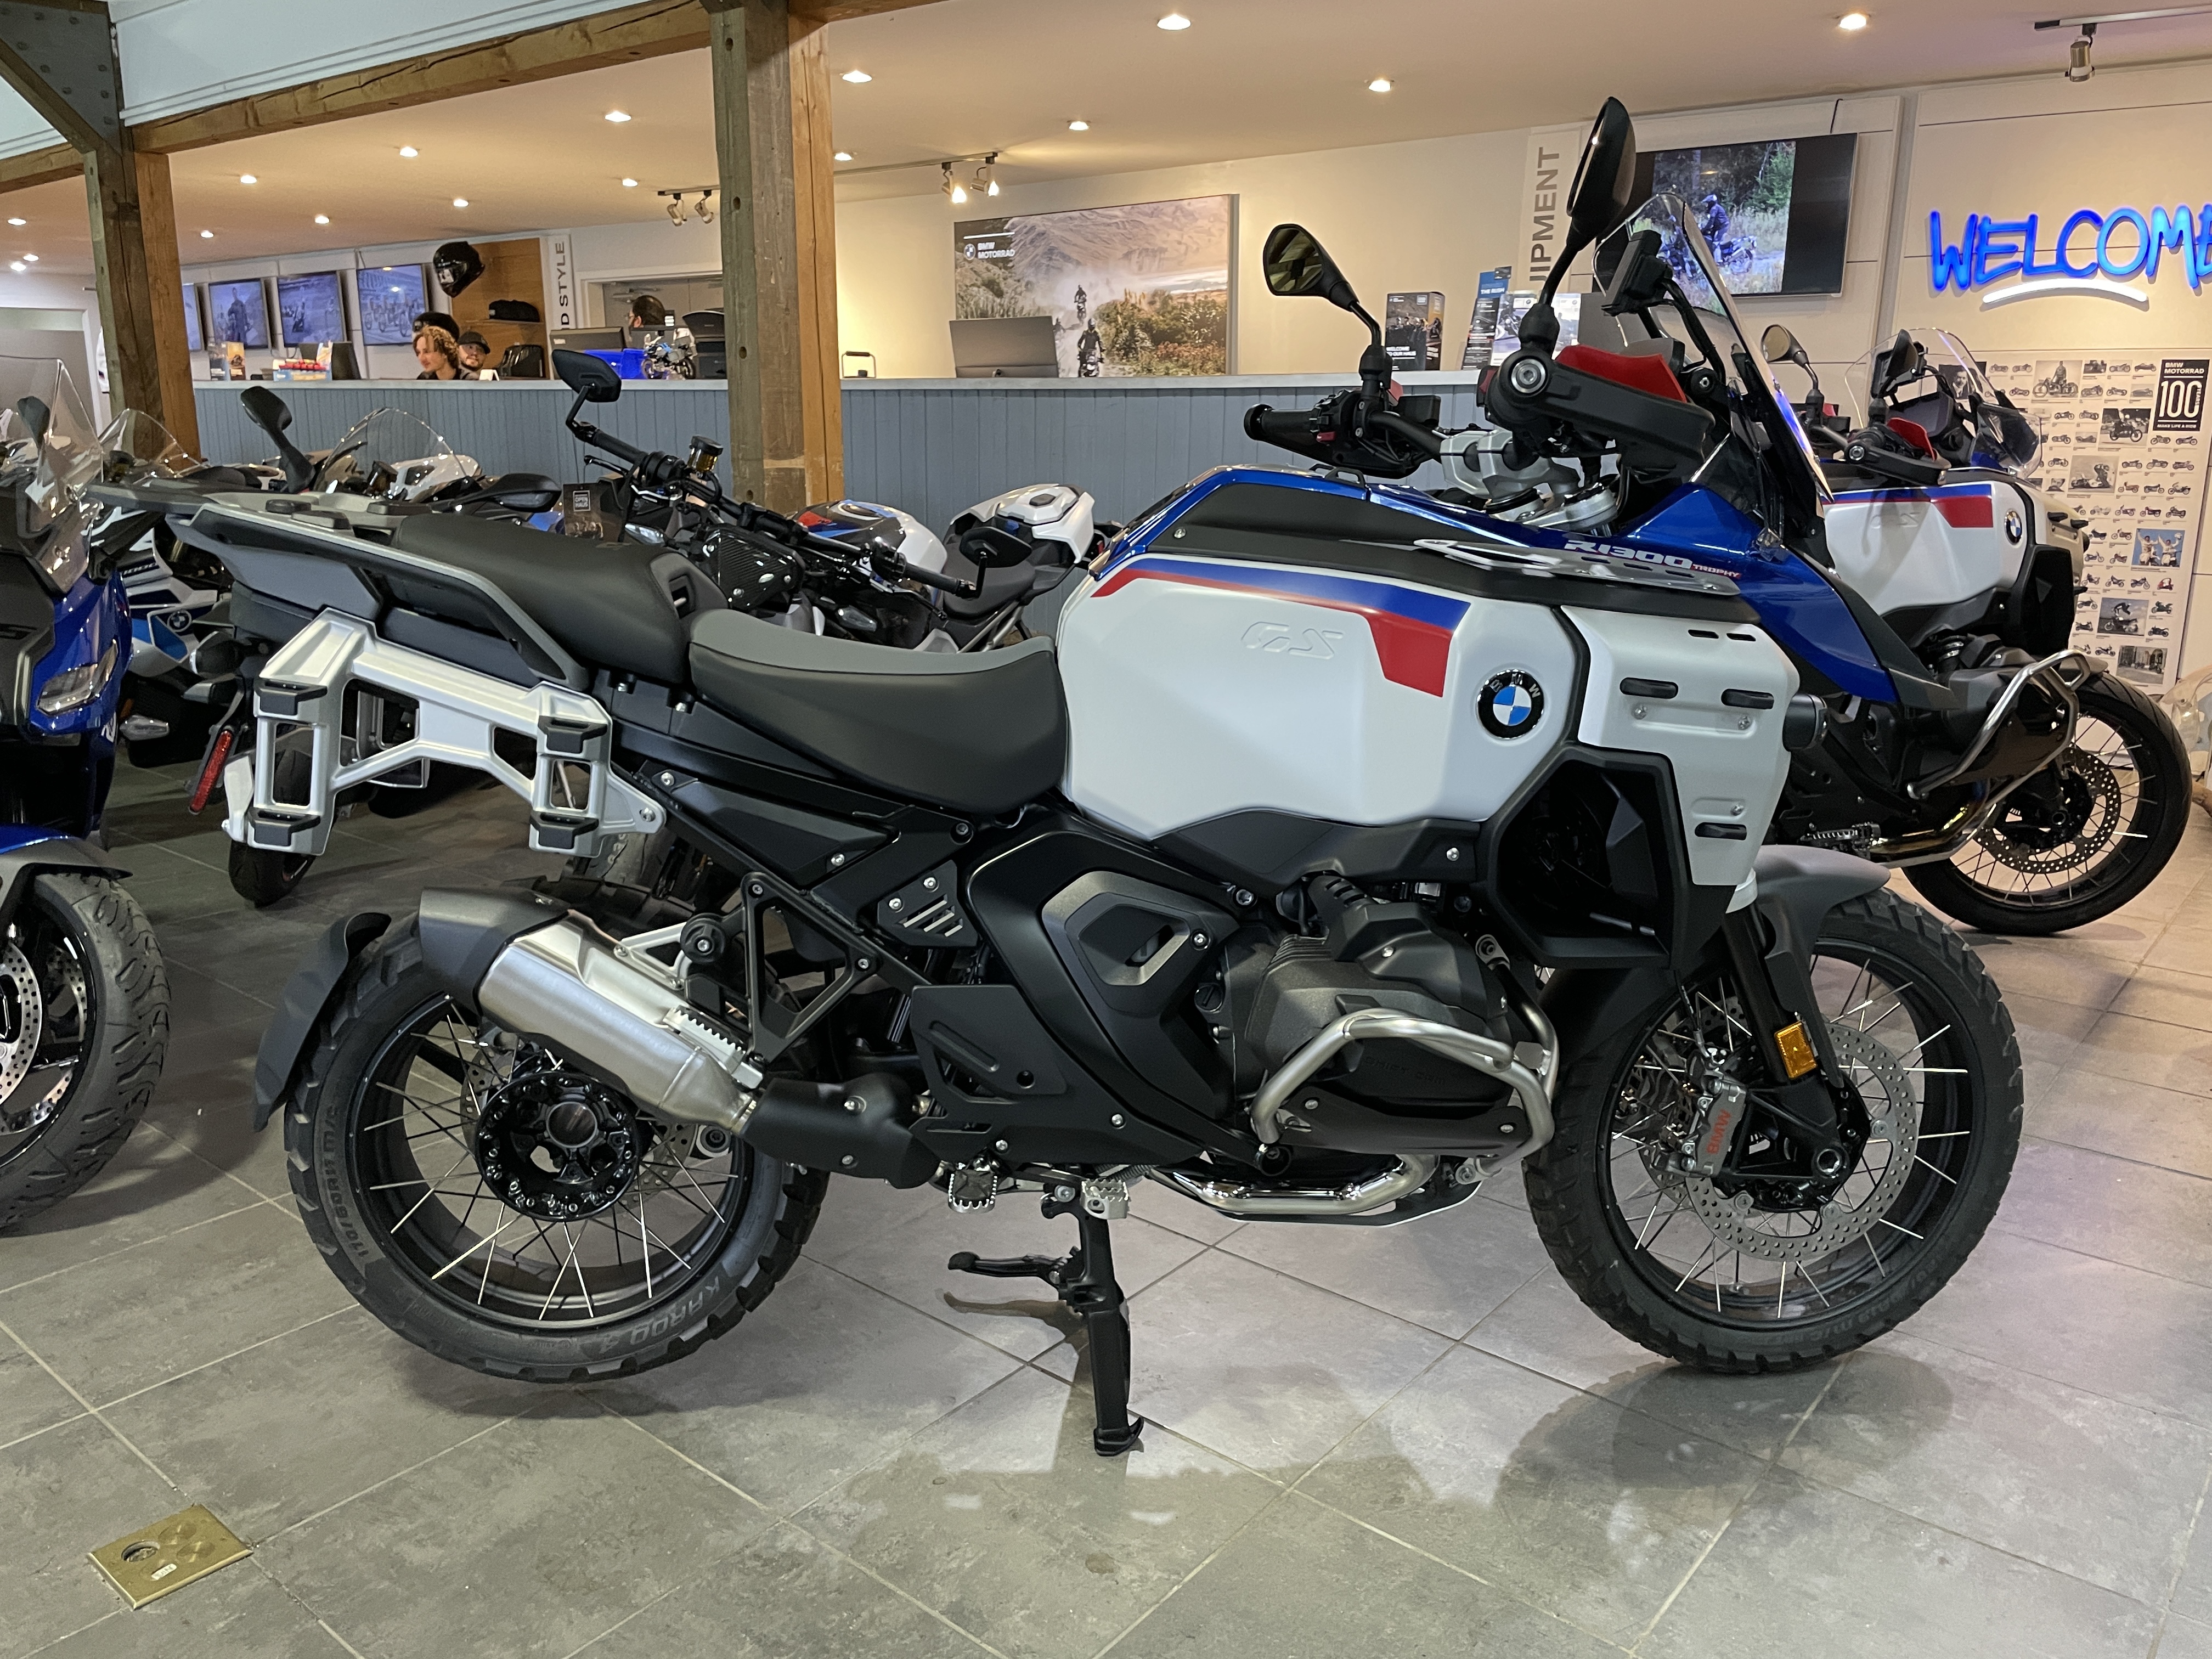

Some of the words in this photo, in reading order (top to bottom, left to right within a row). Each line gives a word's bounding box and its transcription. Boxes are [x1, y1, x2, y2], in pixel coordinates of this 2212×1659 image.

[978, 242, 995, 250] BMW
[978, 249, 1015, 259] MOTORRAD
[555, 241, 568, 307] STYLE
[2159, 380, 2202, 418] 100
[1691, 563, 1741, 578] TROPHY
[1241, 621, 1344, 659] GS
[1490, 673, 1541, 698] BMW
[1706, 1108, 1731, 1154] BMW
[630, 1275, 720, 1346] KAROO
